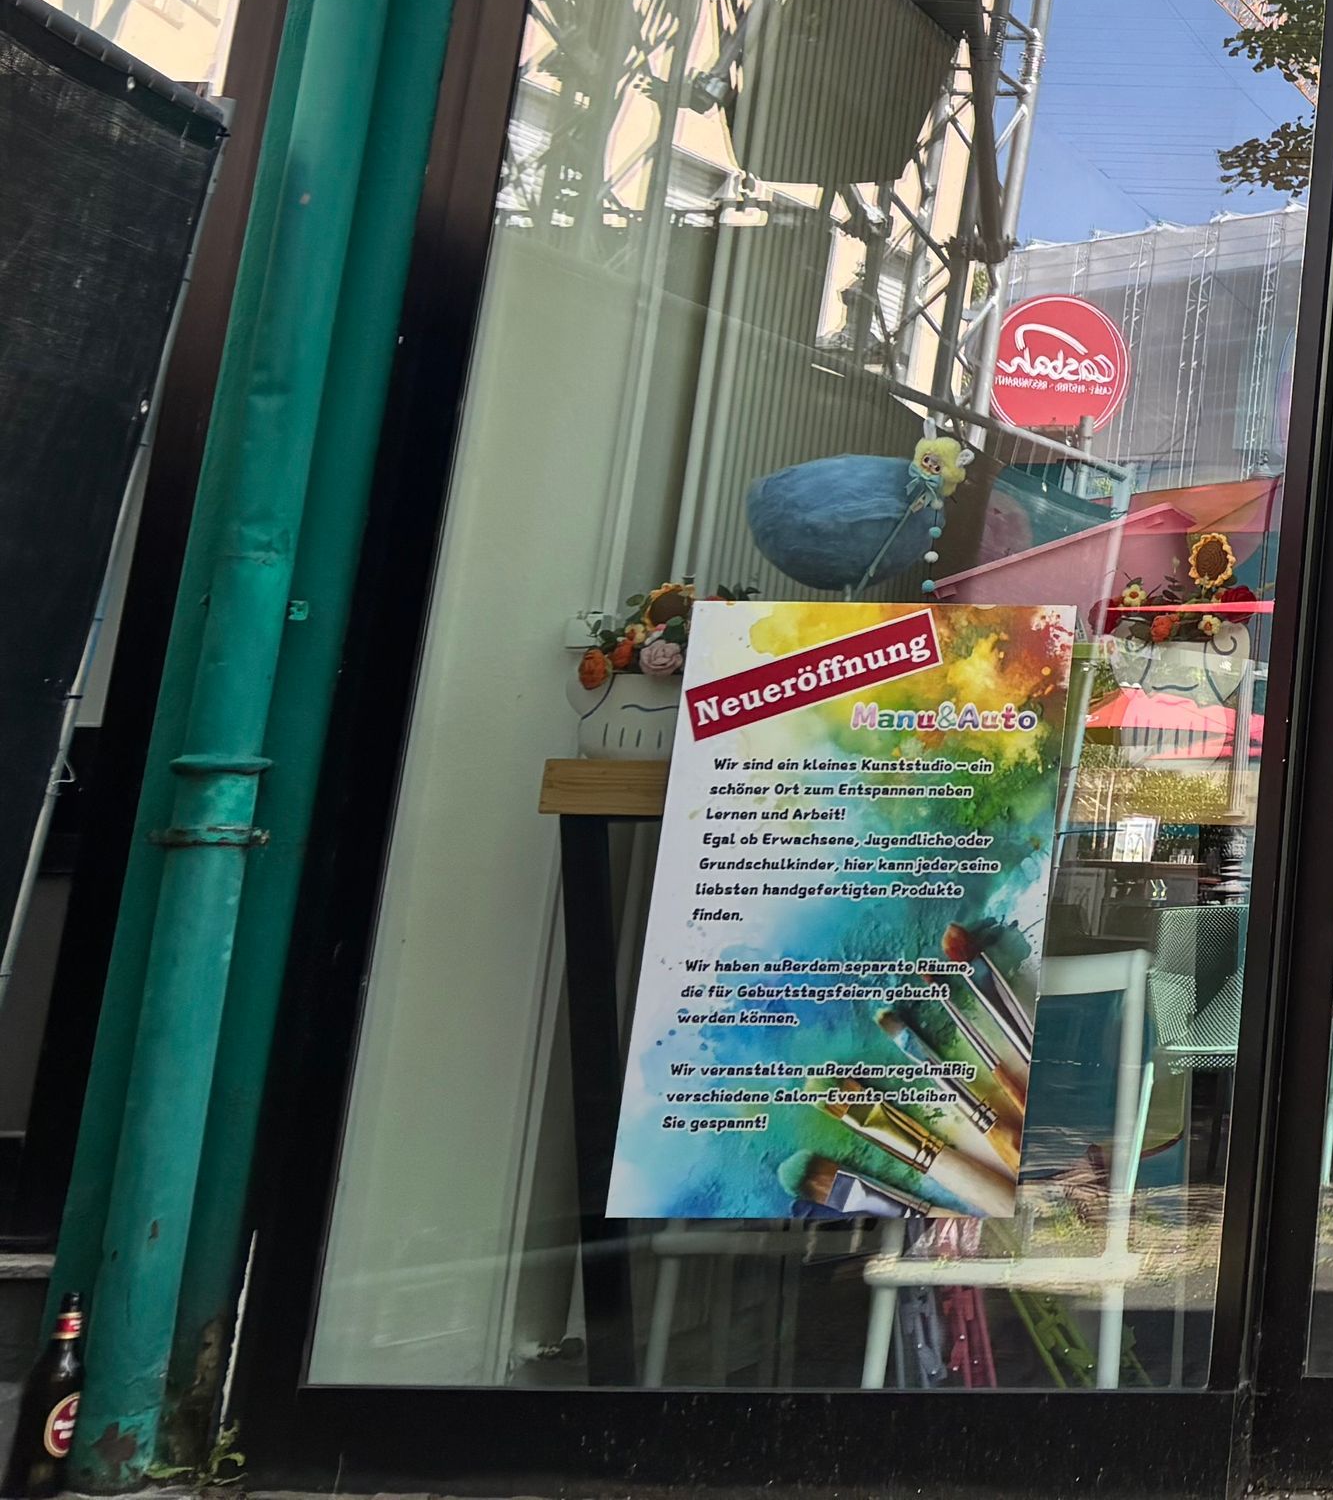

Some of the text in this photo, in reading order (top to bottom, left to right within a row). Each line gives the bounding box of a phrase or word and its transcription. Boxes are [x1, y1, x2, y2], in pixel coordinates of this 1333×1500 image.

[693, 632, 931, 727] Neueröffnung
[850, 702, 1037, 730] Manu&Auto
[714, 758, 739, 770] Wir
[742, 758, 774, 770] sind
[777, 758, 799, 771] ein
[802, 758, 858, 771] kleines
[861, 757, 953, 772] Kunststudio
[970, 758, 993, 773] ein
[709, 782, 973, 799] schöner Ort zum Entspannen neben
[706, 807, 846, 821] Lernen und Arbeit!
[702, 832, 993, 849] Egal ob Erwachsene, Jugendliche oder
[699, 857, 1000, 875] Grundschulkinder, hier kann jeder seine
[695, 882, 963, 899] liebsten handgefertigten Produkte
[692, 908, 745, 922] finden.
[685, 959, 975, 977] Wir haben außerdem separate Räume,
[680, 985, 949, 1003] die für Geburtstagsfeiern gebucht
[677, 1010, 800, 1025] werden können.
[670, 1063, 976, 1081] Wir veranstalten außerdem regelmäßig
[666, 1089, 770, 1103] verschiedene
[774, 1089, 882, 1103] Salon-Events
[899, 1089, 958, 1104] bleiben
[662, 1115, 767, 1133] Sie gespannt!
